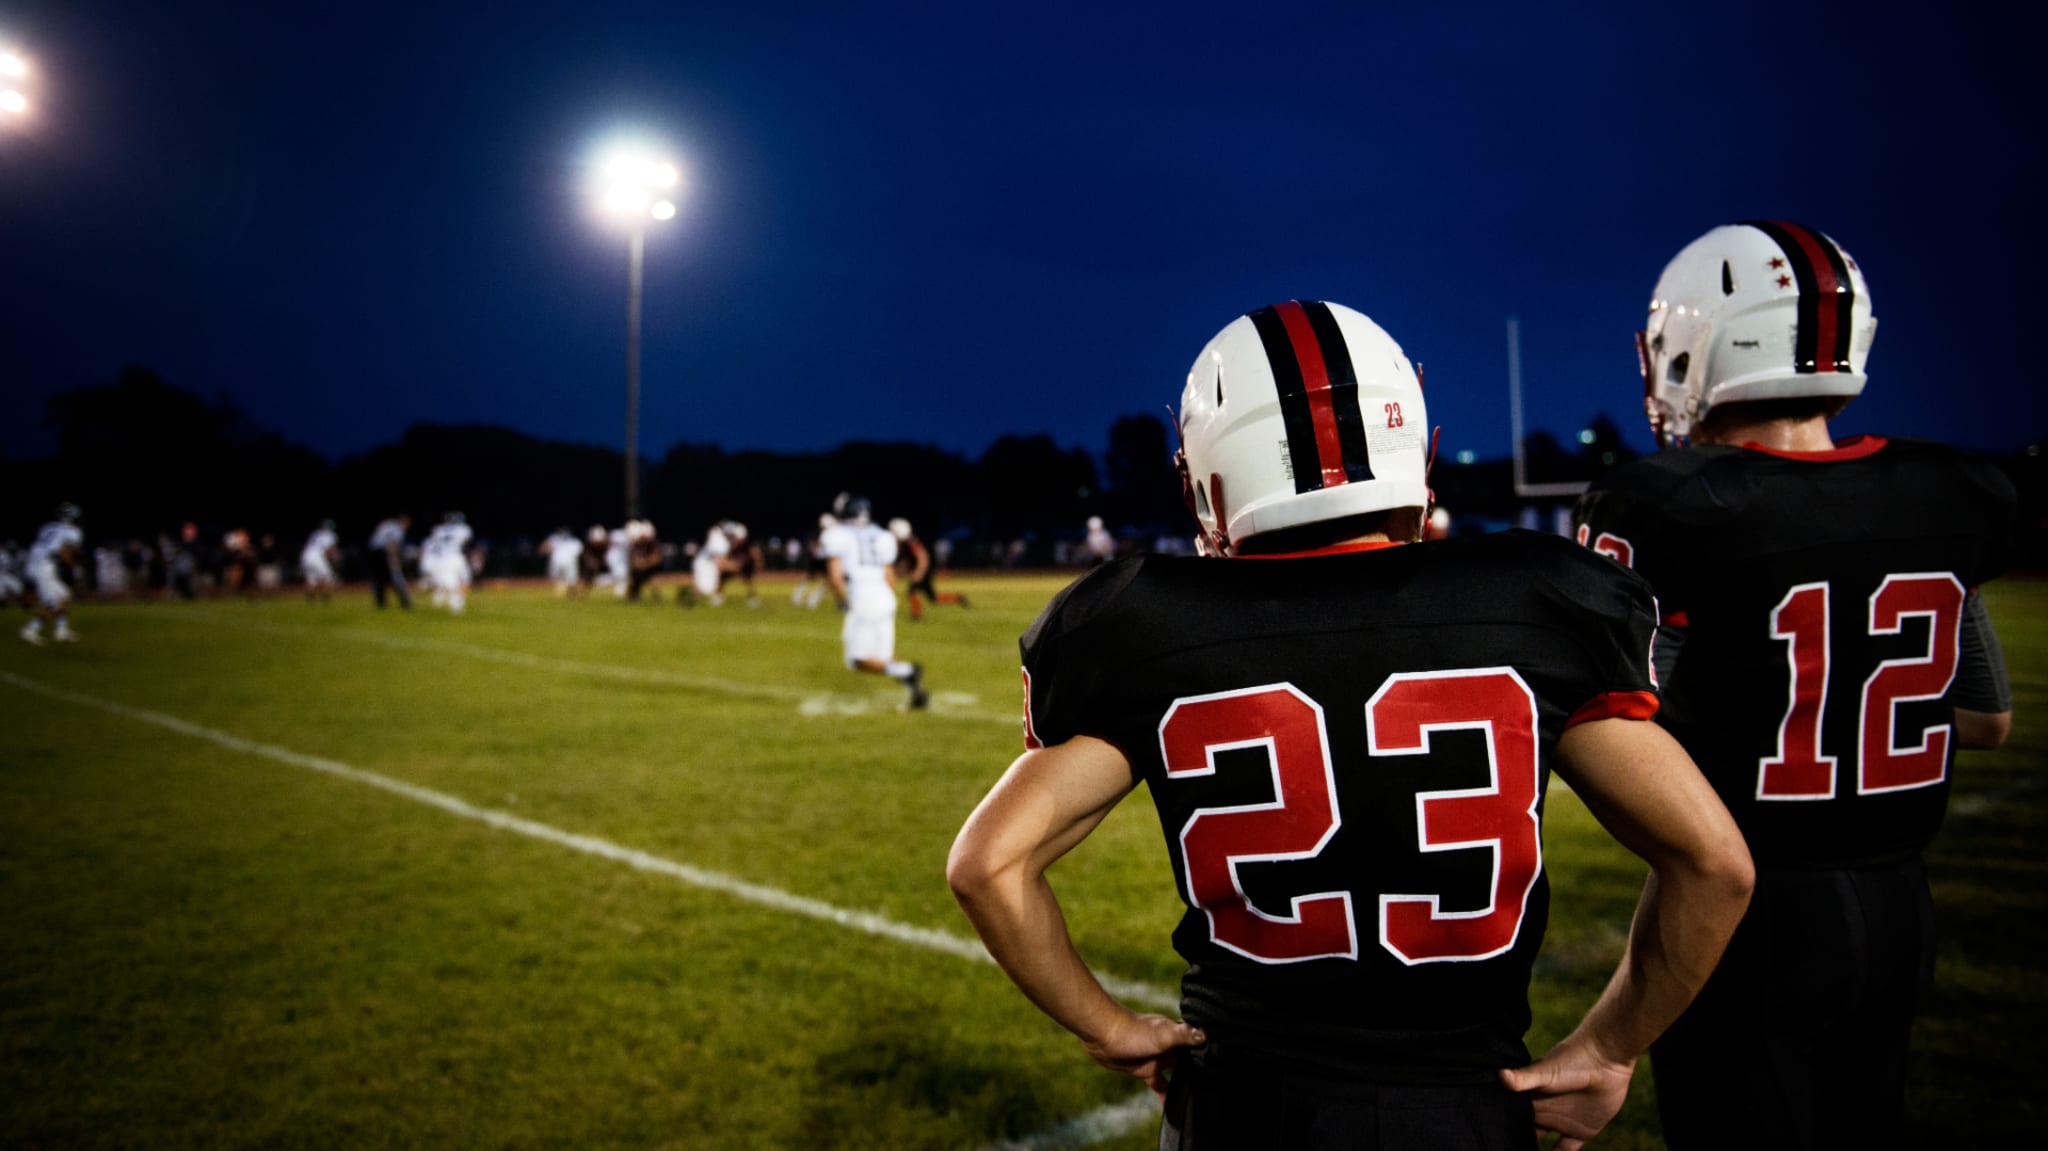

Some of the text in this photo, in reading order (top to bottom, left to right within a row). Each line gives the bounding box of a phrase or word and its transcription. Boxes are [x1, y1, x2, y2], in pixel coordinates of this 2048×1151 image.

[1384, 401, 1404, 428] 23
[1756, 571, 1966, 800] 12
[1158, 666, 1541, 966] 23
